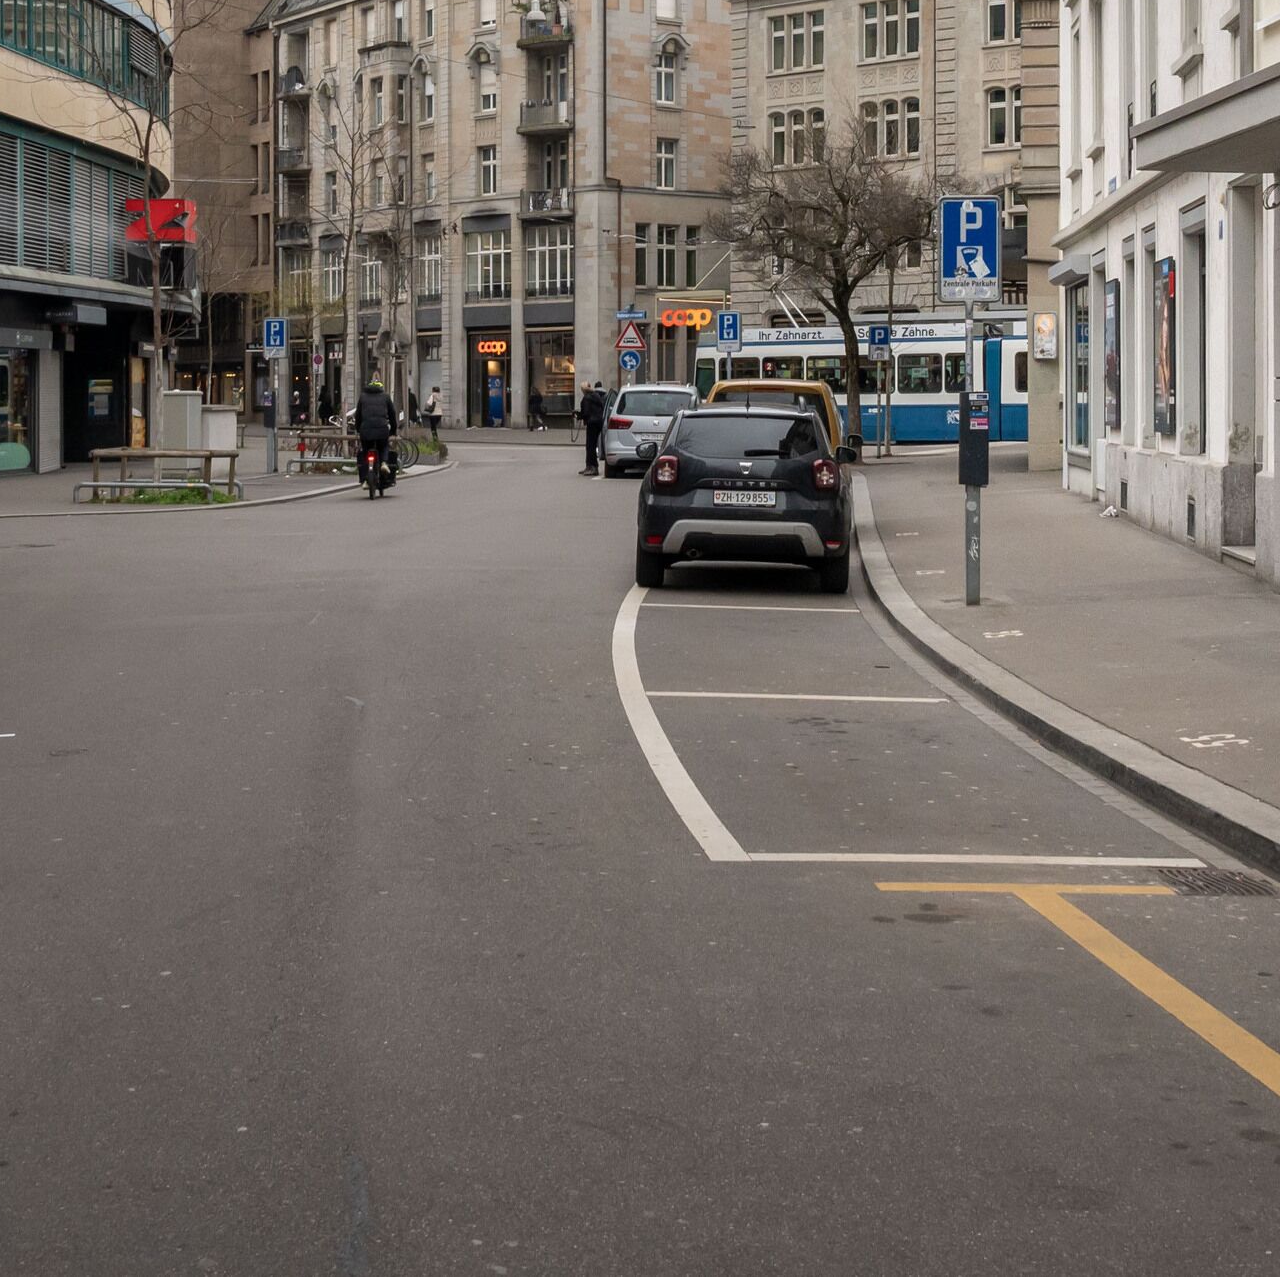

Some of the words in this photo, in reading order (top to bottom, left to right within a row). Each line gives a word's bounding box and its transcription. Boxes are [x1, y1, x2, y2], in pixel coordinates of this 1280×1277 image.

[960, 206, 983, 243] P
[971, 279, 997, 287] Parkuhr
[661, 309, 713, 331] coop
[758, 330, 772, 340] Ihr
[775, 330, 825, 340] Zahnarzt.
[478, 340, 507, 355] coop
[713, 480, 778, 488] DUSTER
